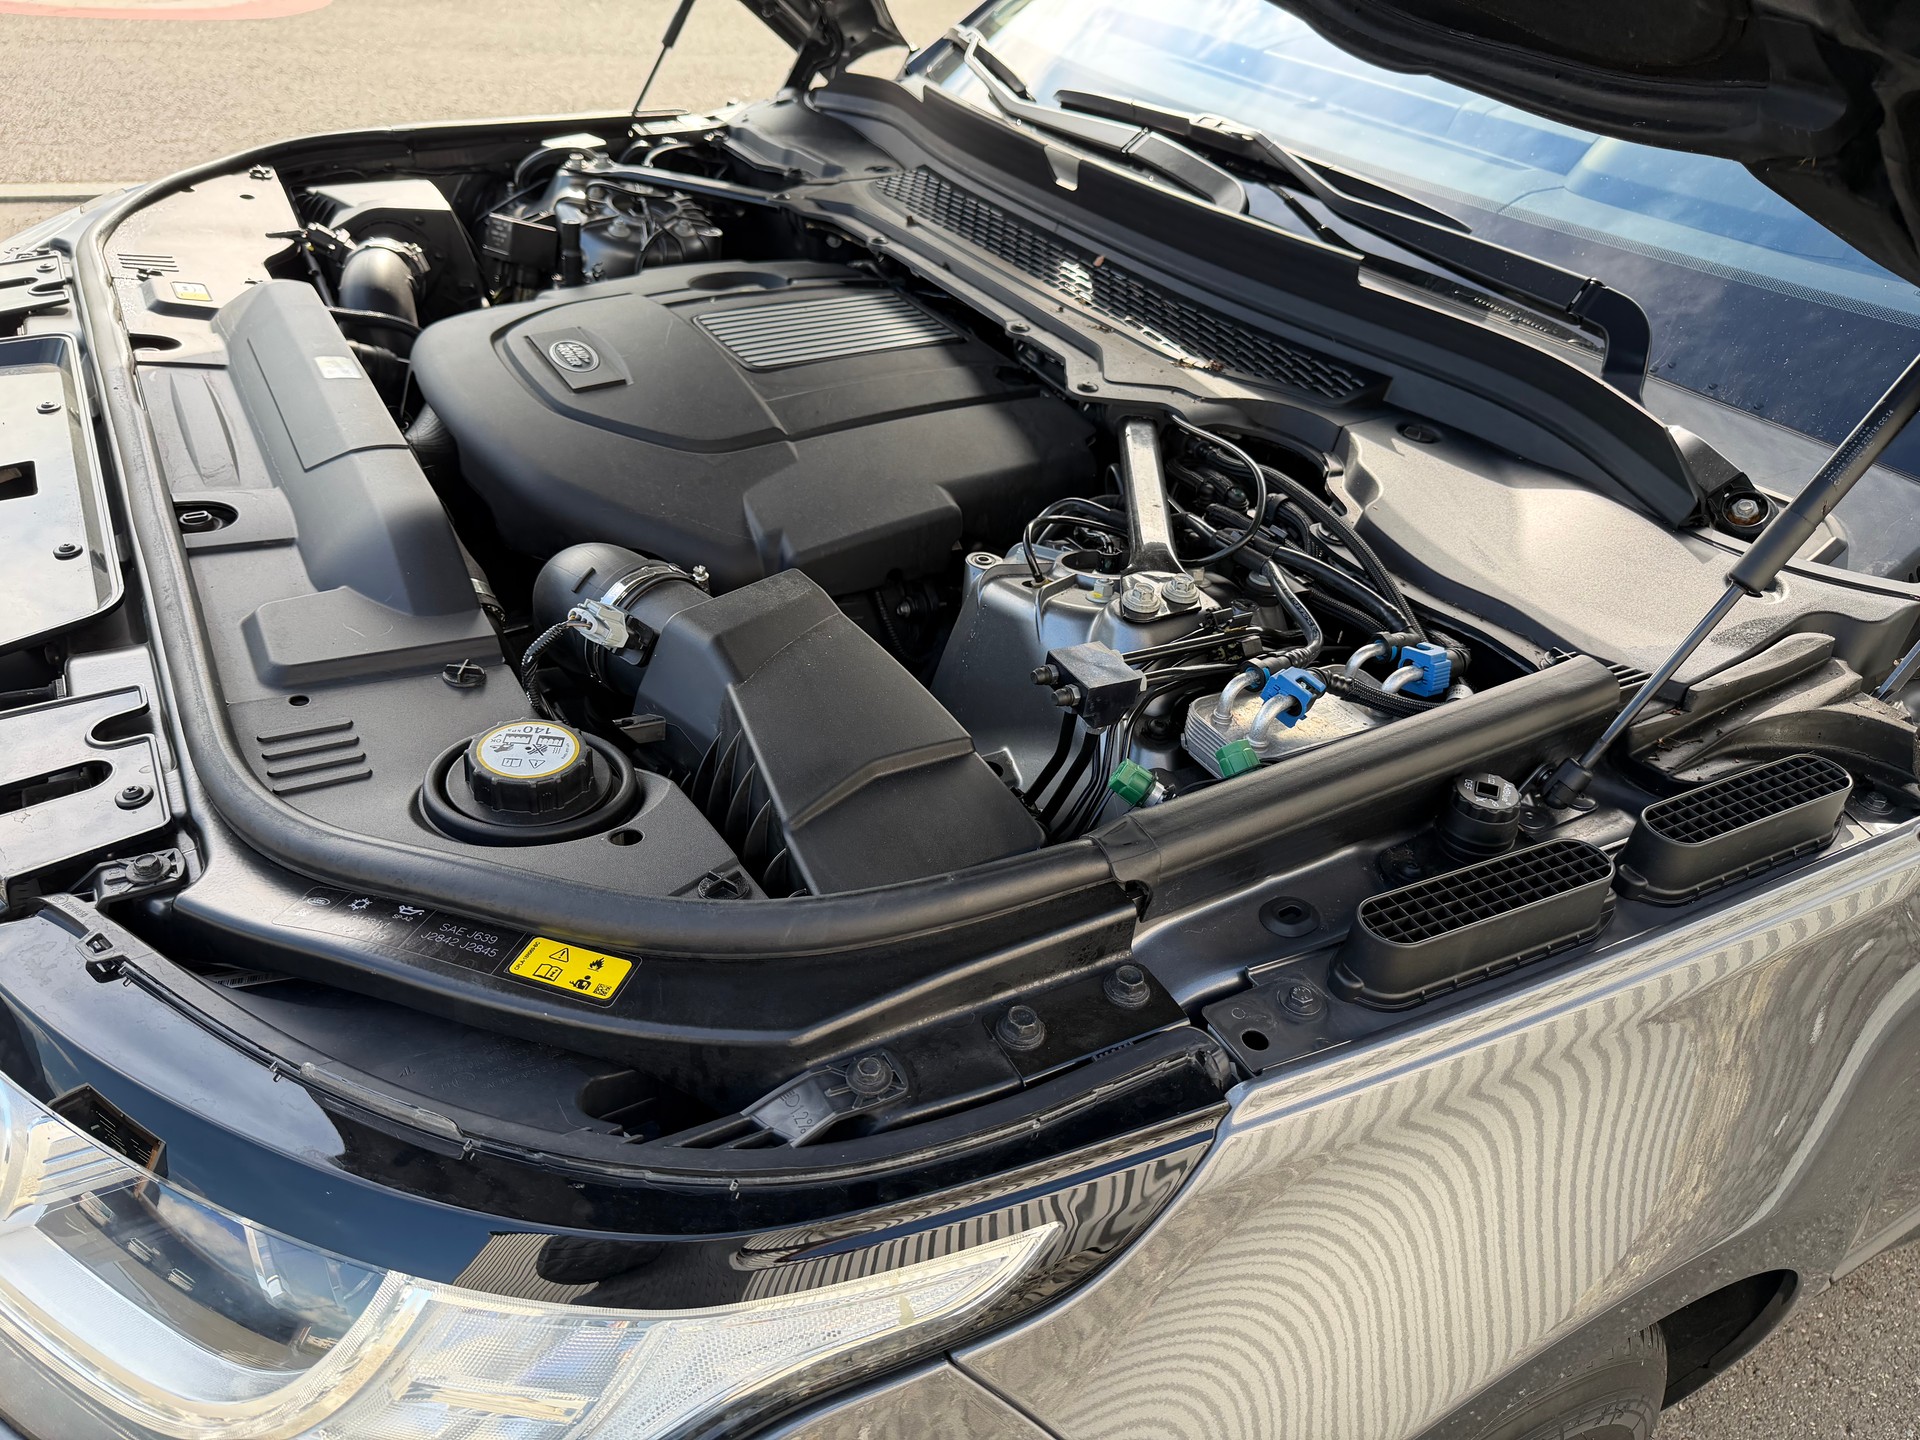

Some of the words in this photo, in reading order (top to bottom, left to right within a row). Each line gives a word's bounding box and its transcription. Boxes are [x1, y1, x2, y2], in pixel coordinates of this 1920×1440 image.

[522, 725, 552, 735] 140
[420, 931, 460, 947] J2842
[459, 941, 499, 958] J2845
[439, 923, 467, 937] SAE
[466, 930, 499, 945] J639
